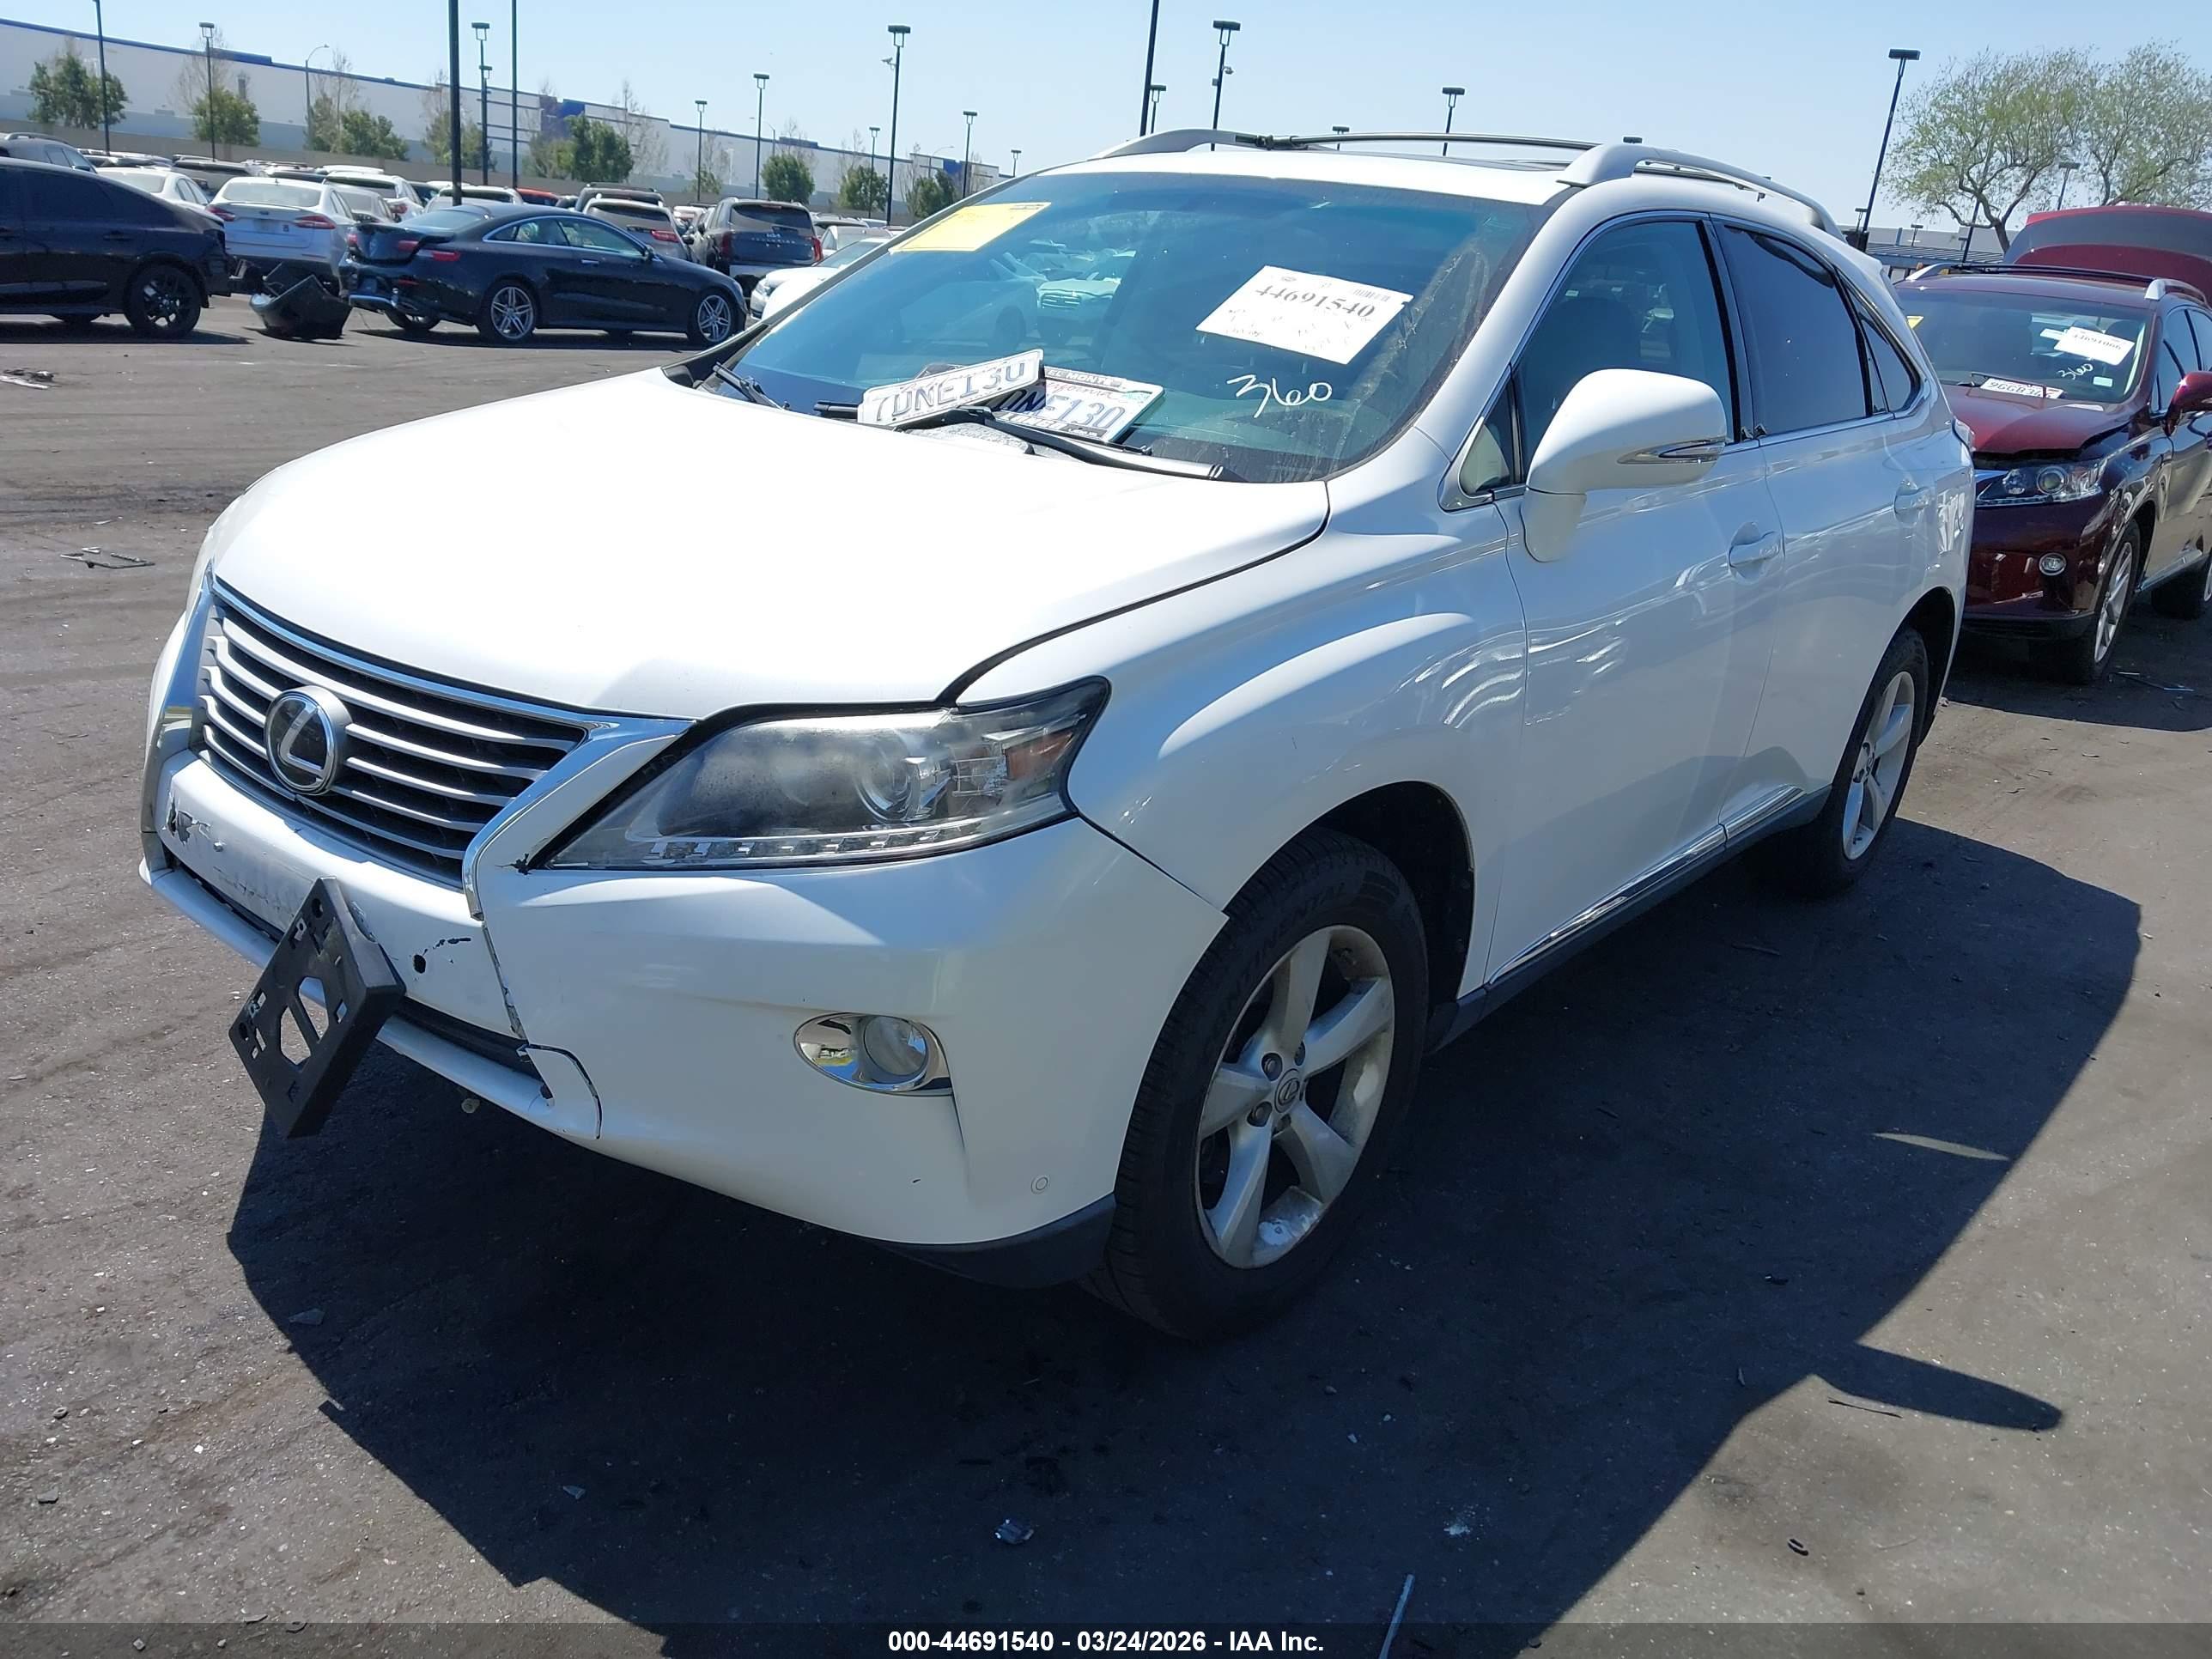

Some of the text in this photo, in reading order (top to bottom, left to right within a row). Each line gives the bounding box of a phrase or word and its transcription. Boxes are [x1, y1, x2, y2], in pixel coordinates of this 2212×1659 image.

[1255, 284, 1376, 319] 44691540
[1048, 369, 1113, 386] EL MONTE
[2057, 363, 2094, 380] 360
[1226, 374, 1333, 419] 360
